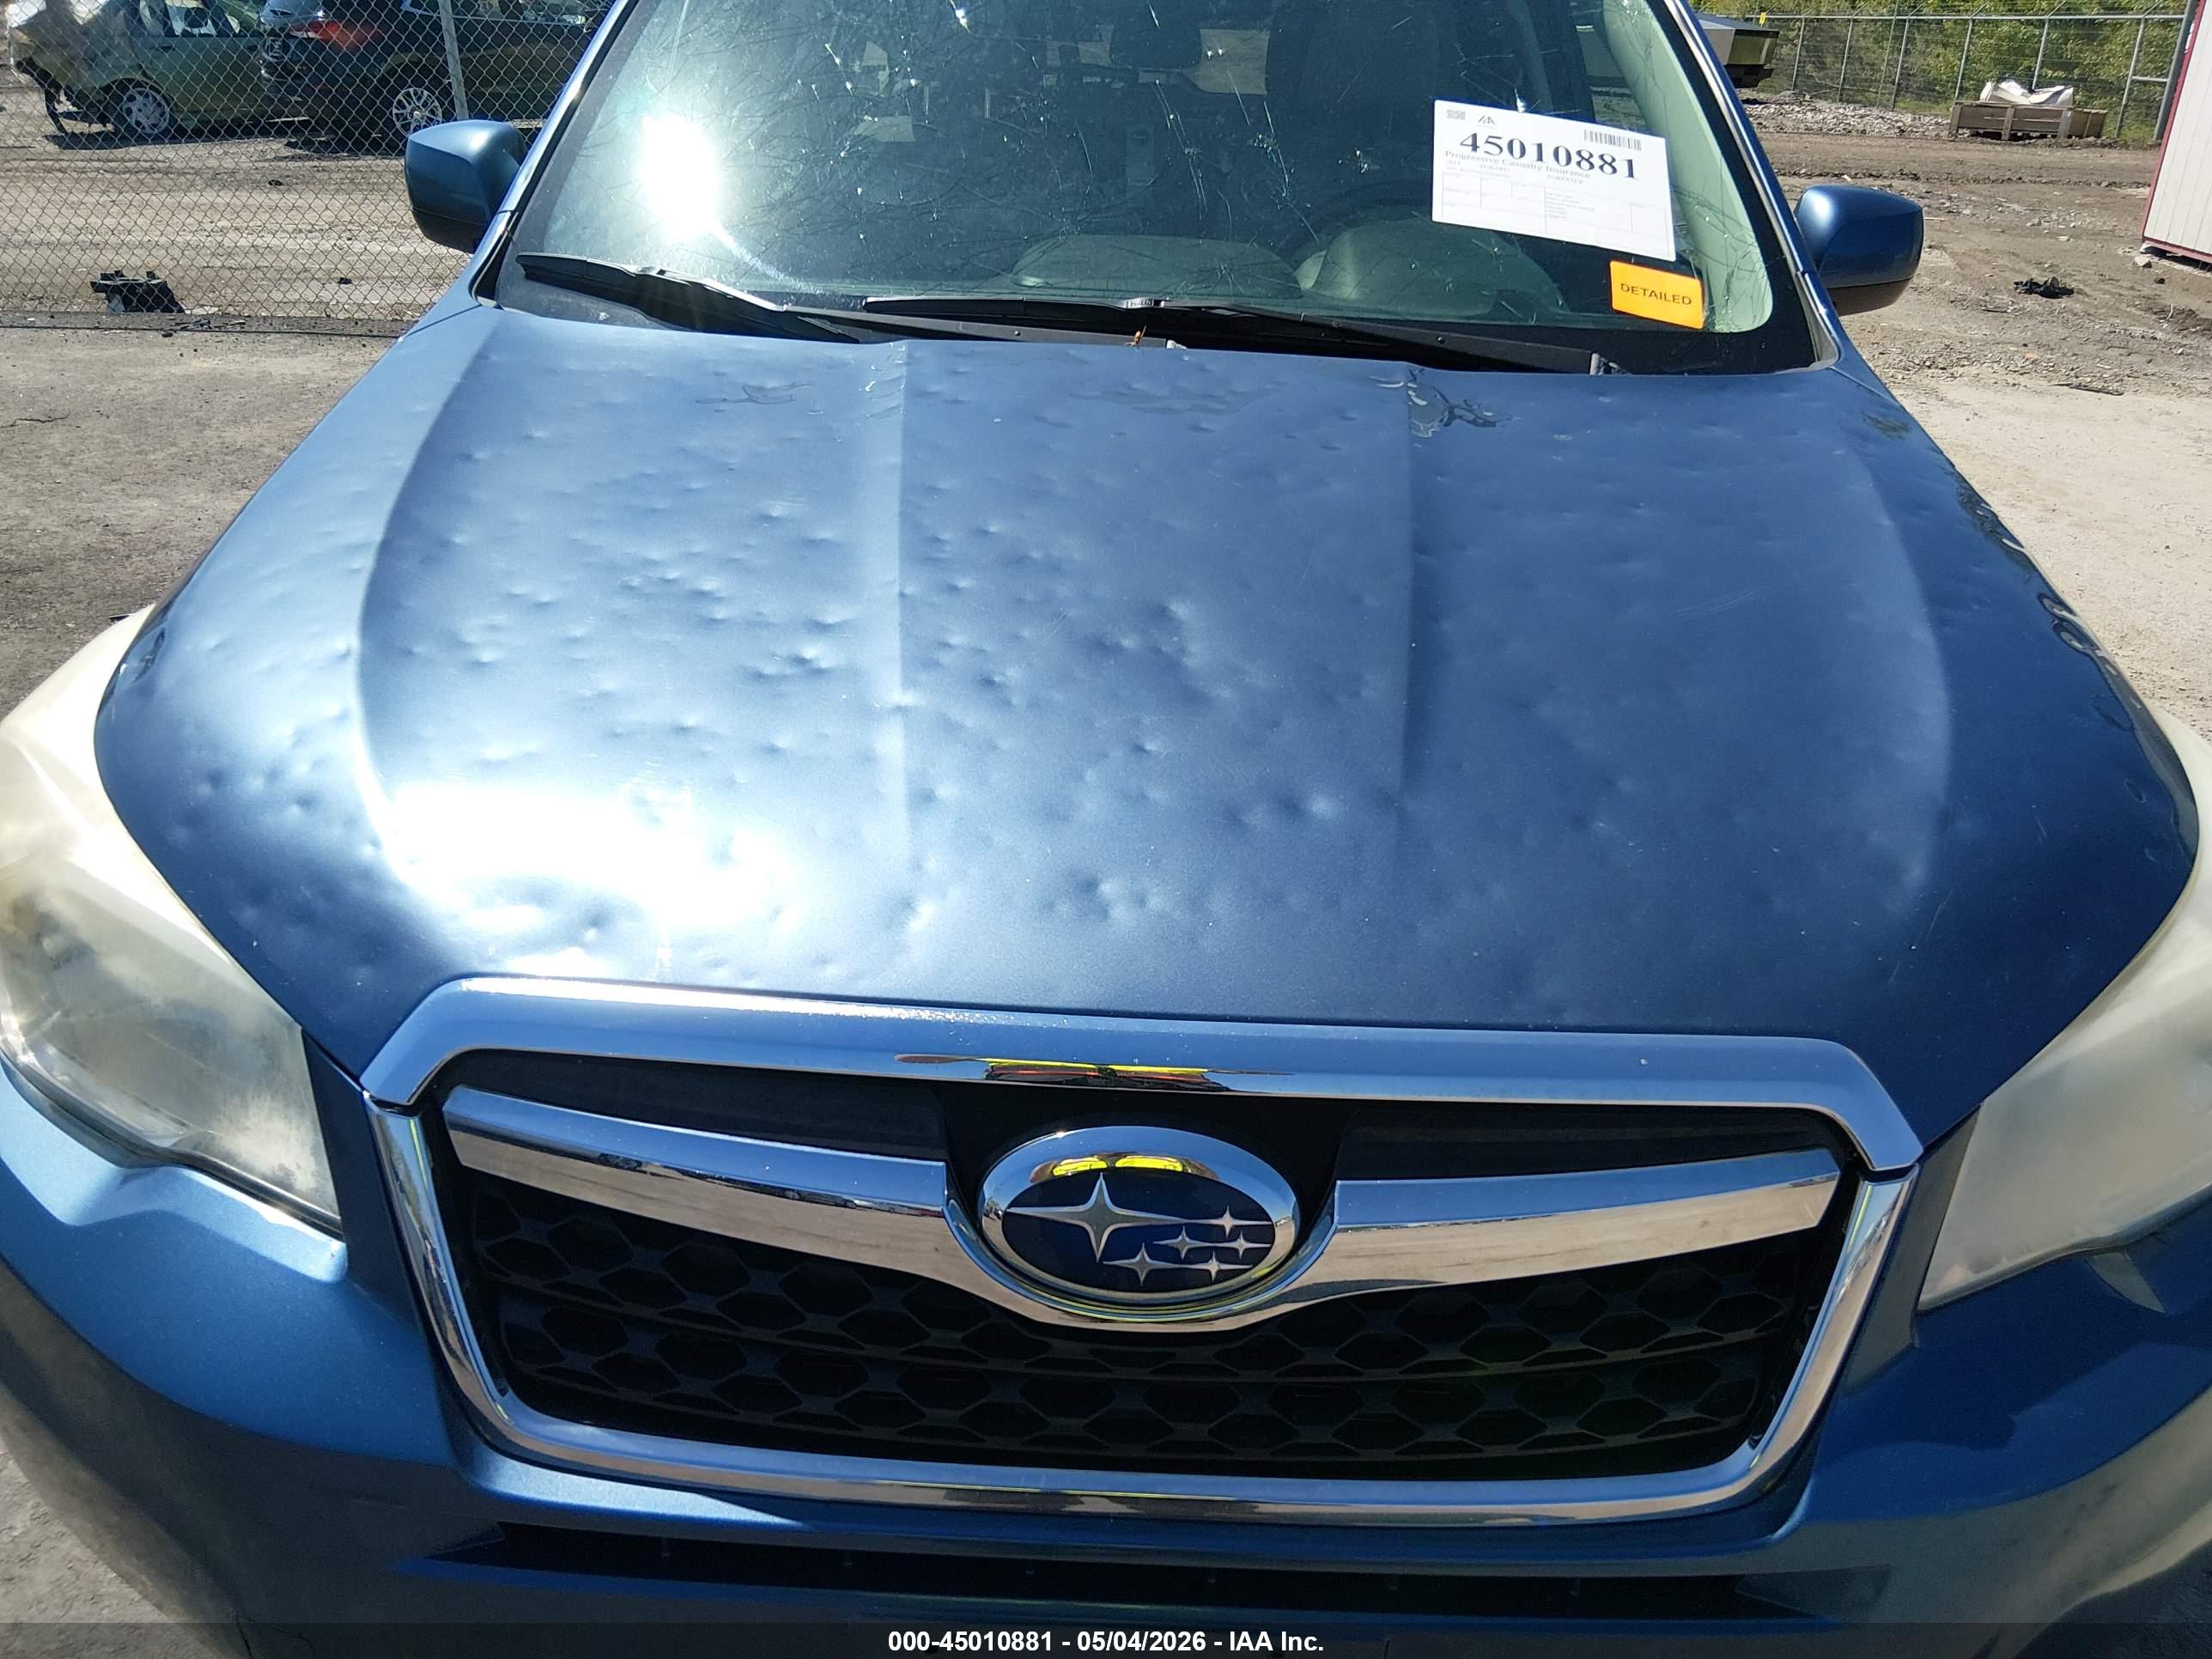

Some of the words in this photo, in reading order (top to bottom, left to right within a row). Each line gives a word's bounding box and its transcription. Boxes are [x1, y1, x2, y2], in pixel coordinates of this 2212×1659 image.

[1444, 150, 1499, 164] Progressive
[1502, 159, 1543, 172] Casualty
[1546, 165, 1590, 179] Insurance
[1460, 132, 1638, 179] 45010881
[1620, 283, 1692, 305] DETAILED
